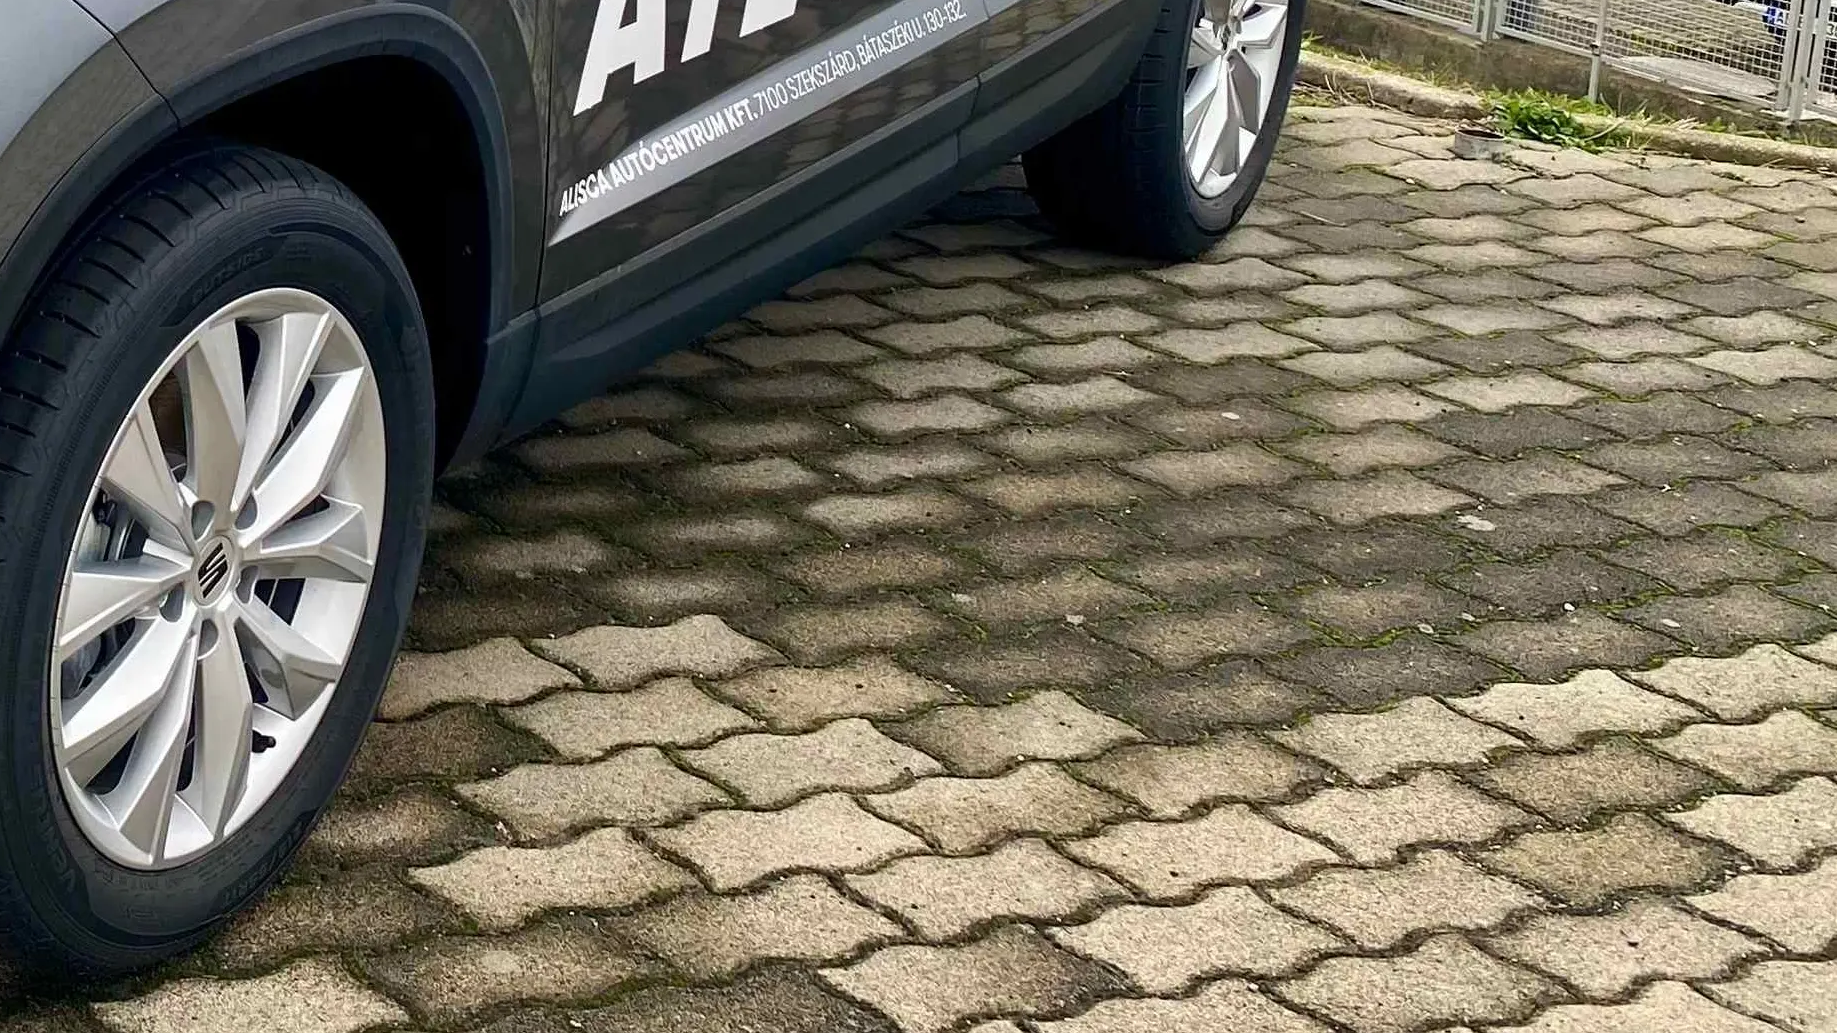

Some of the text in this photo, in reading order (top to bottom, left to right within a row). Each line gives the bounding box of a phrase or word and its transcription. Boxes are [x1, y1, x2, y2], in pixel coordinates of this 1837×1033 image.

[559, 168, 613, 216] ALISCA
[608, 109, 729, 188] AUTÓCENTRUM
[754, 82, 789, 116] 7100
[786, 49, 860, 99] SZEKSZÁRD,
[857, 21, 914, 65] BÁTASZÉKI
